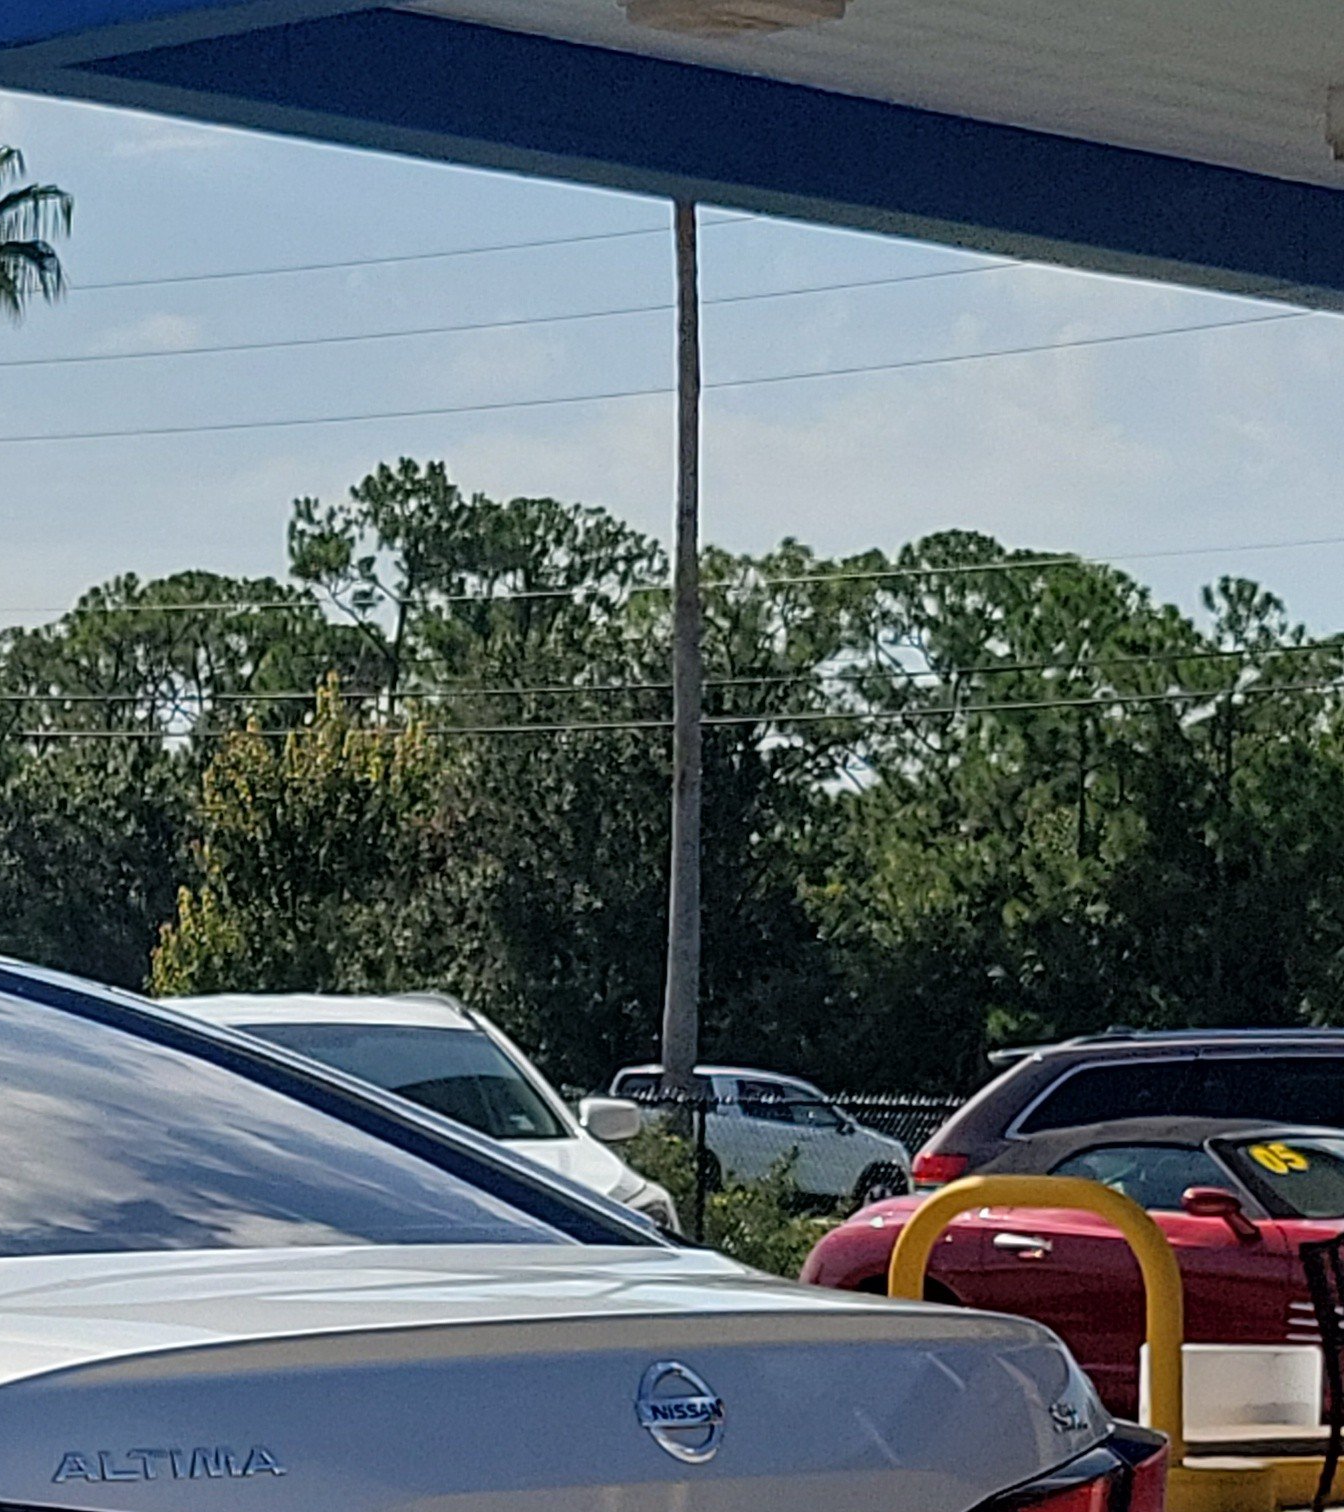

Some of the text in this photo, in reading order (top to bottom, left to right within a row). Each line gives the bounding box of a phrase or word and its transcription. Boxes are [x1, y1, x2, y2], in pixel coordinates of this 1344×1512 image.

[1248, 1141, 1309, 1175] 05
[650, 1399, 724, 1422] NISSAN
[52, 1444, 288, 1483] ALTIMA
